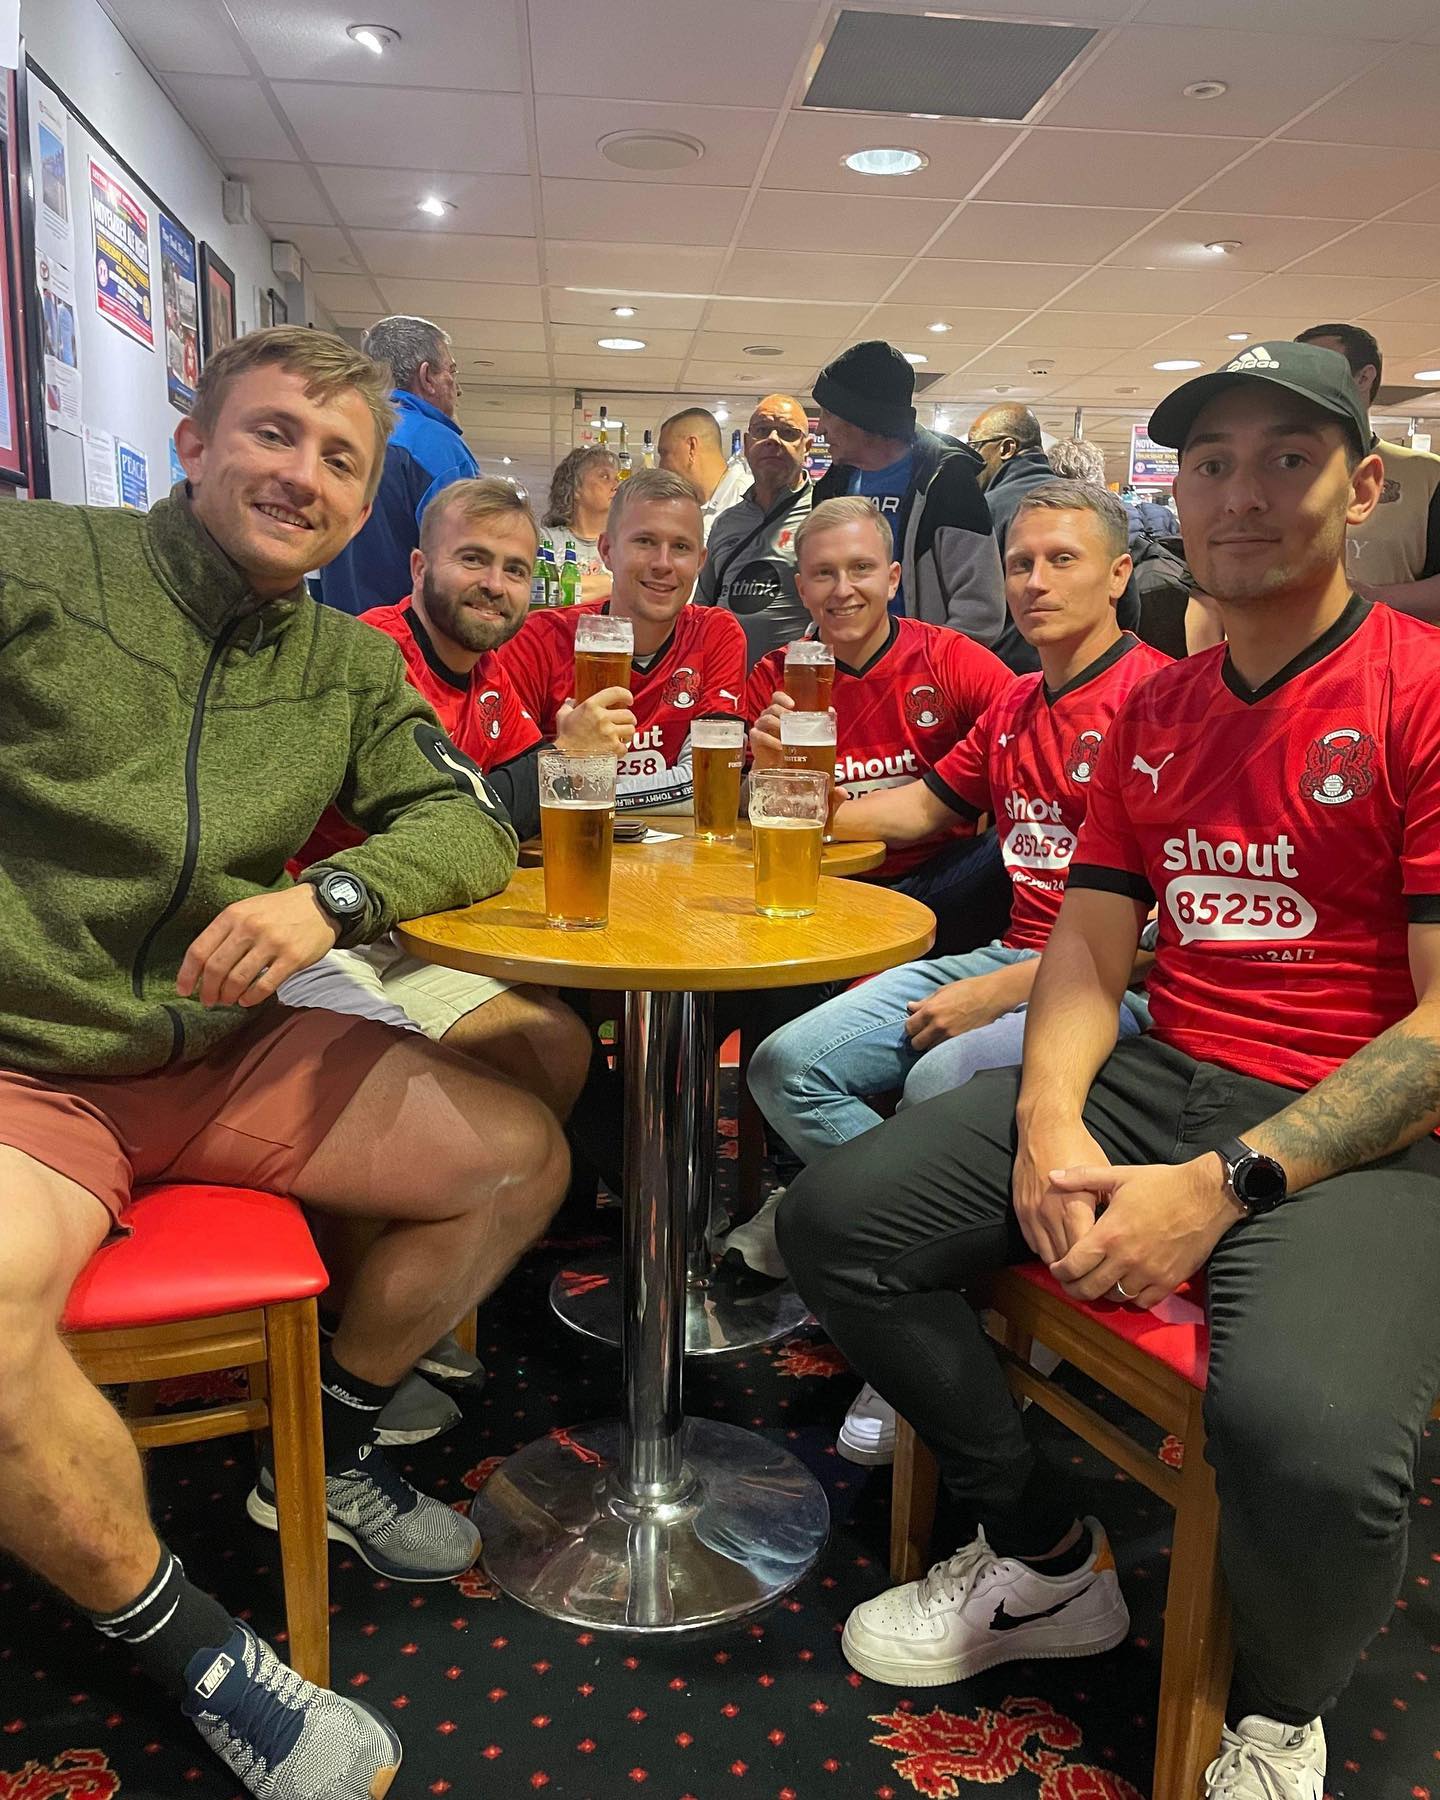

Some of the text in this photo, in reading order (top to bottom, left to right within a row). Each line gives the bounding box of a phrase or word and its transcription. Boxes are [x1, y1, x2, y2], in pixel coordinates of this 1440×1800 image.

[121, 453, 145, 482] PEACE
[864, 496, 900, 513] AR
[616, 757, 657, 776] 258
[834, 749, 918, 783] shout
[645, 791, 672, 804] TOMMY
[1011, 833, 1073, 859] 85258
[1162, 828, 1299, 879] shout
[1052, 879, 1065, 892] 24
[1176, 891, 1303, 929] 85258
[1266, 948, 1316, 962] 24/7
[203, 1659, 227, 1693] NIKE
